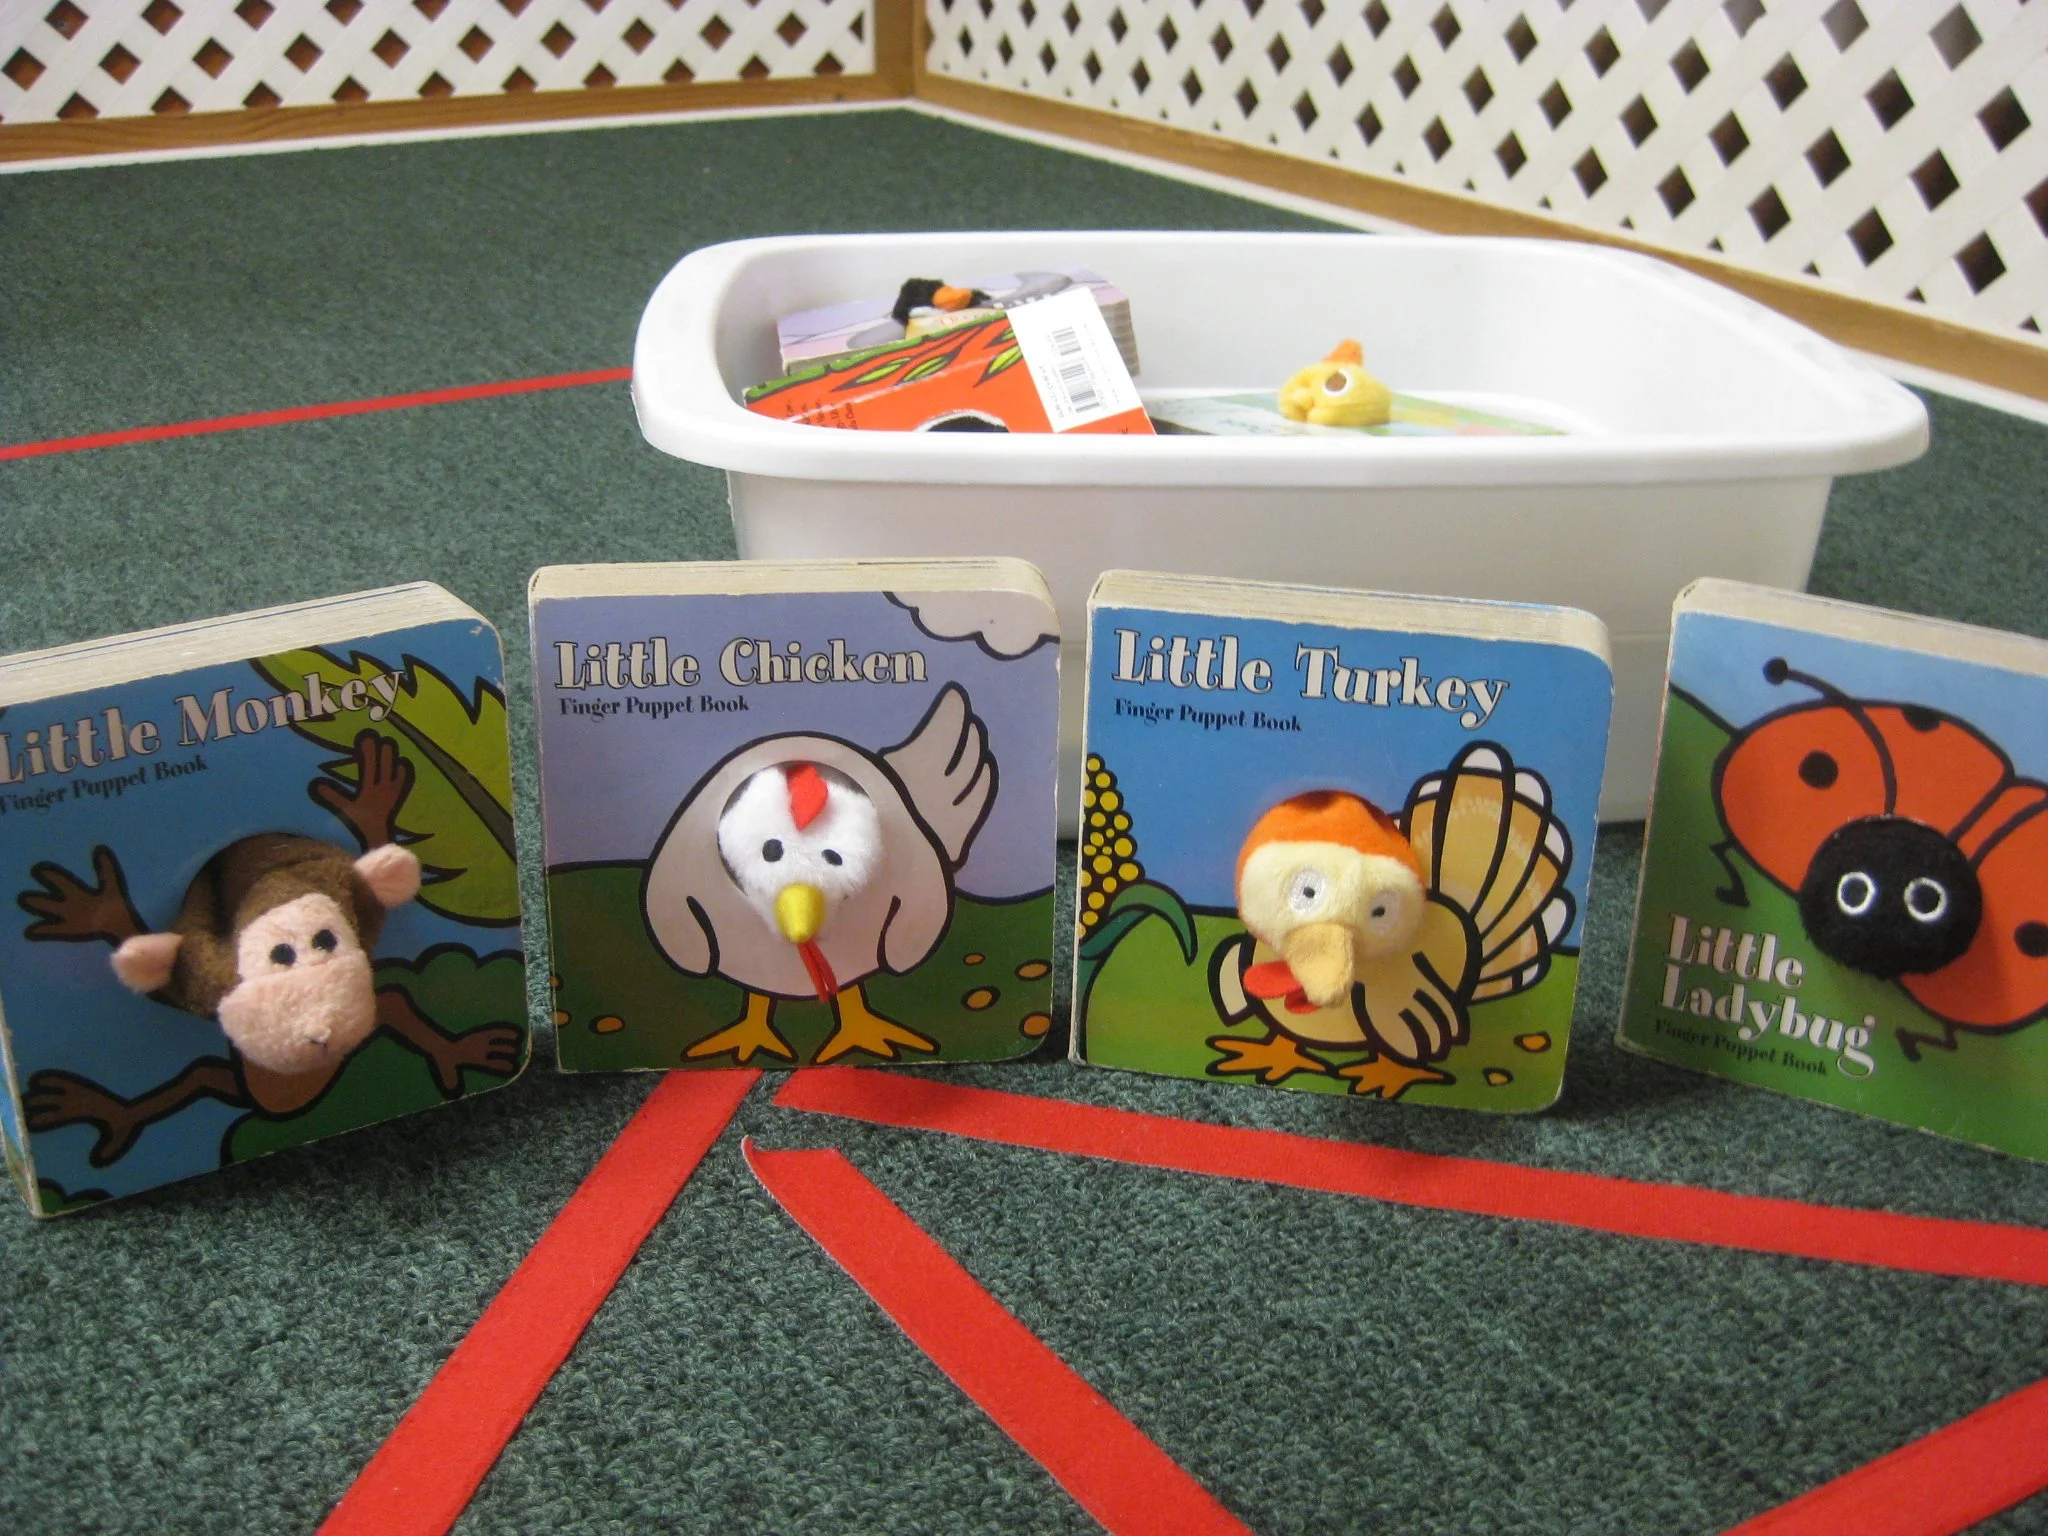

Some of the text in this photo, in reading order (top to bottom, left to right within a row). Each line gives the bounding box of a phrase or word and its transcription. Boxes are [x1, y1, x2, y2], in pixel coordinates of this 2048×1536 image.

[553, 637, 929, 691] Little Chicken
[1111, 628, 1510, 731] Little Turkey
[174, 670, 405, 747] Monkey
[559, 694, 750, 722] Finger Puppet Book
[1114, 698, 1302, 733] Finger Puppet Book
[71, 766, 148, 799] Puppet
[153, 754, 210, 782] Book
[1665, 913, 1804, 990] Little
[1656, 963, 1877, 1079] Ladybug
[1713, 1032, 1777, 1064] Puppet
[1782, 1050, 1828, 1077] Book
